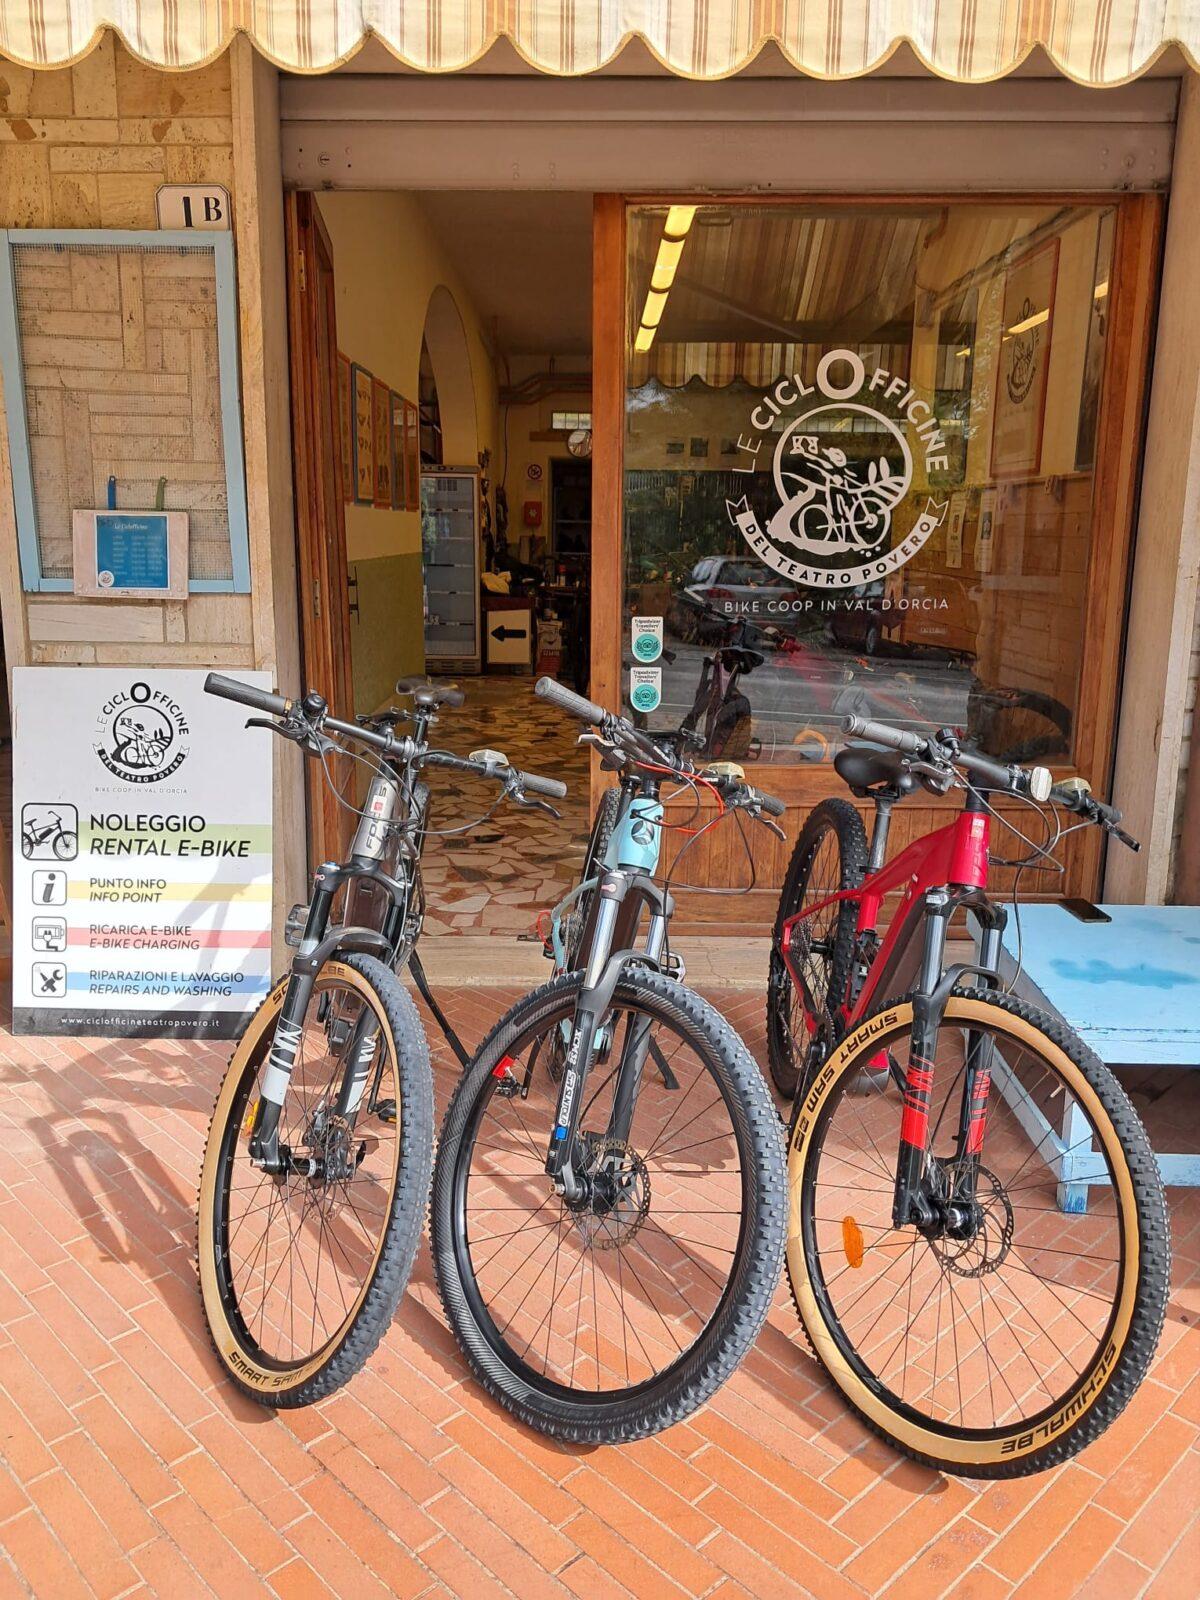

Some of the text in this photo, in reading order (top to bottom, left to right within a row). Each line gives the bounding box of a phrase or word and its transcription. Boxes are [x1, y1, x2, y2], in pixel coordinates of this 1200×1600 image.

[203, 196, 222, 222] B
[732, 349, 949, 474] LE CICLOFFICINE
[745, 520, 931, 585] DEL TEATRO POVERO
[725, 598, 949, 612] BIKE COOP IN VAL D'ORCIA
[95, 682, 190, 736] LE CICLOFFICINE
[100, 753, 184, 783] DEL TEATRO POVERO
[90, 814, 206, 832] NOLEGGIO
[90, 838, 251, 858] RENTAL E-BIKE
[90, 878, 166, 889] PUNTO INFO
[90, 892, 162, 903] INFO POINT
[90, 925, 191, 936] RICARICA E-BIKE
[90, 938, 200, 950] E-BIKE CHARGING
[90, 970, 244, 983] RIPARAZIONI E LAVAGGIO
[90, 983, 232, 996] REPAIRS AND WASHING
[61, 1016, 220, 1028] www.ciclofficineteatropovero.it
[808, 1012, 898, 1113] SMART SAM
[228, 1351, 269, 1386] SMART
[1001, 1340, 1117, 1454] SCHWALBE
